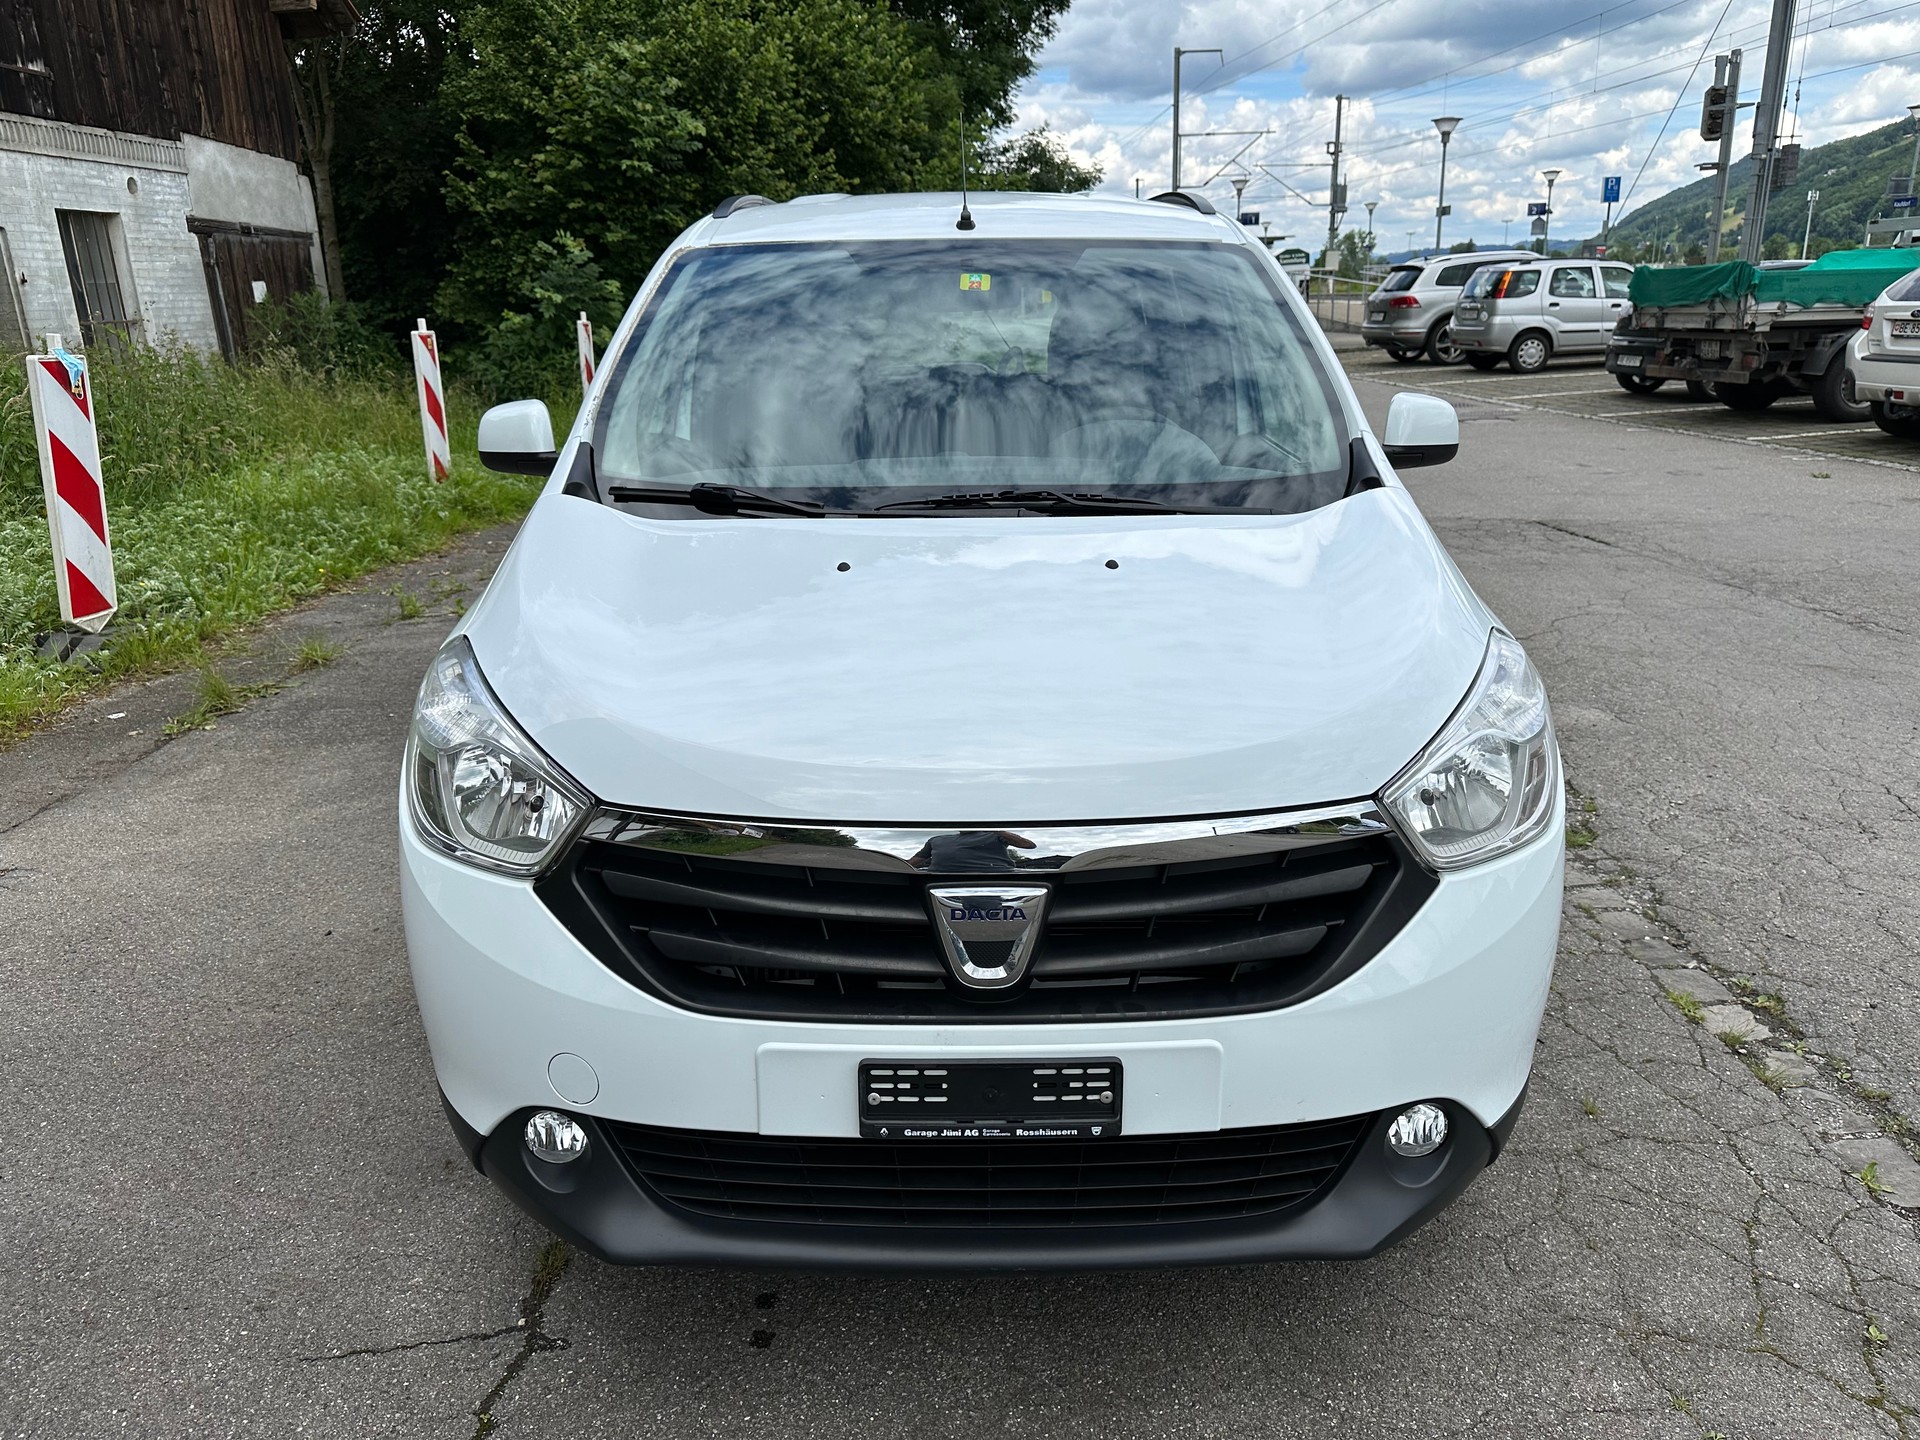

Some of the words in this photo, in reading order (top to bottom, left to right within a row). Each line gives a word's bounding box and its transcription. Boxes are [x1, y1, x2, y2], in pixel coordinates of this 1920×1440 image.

[968, 281, 982, 289] 23
[1899, 322, 1910, 333] BE
[951, 908, 1027, 921] DACIA
[904, 1129, 938, 1137] Garage
[941, 1128, 961, 1137] Jüni
[964, 1129, 979, 1137] AG
[1016, 1128, 1078, 1137] Rosshäusern
